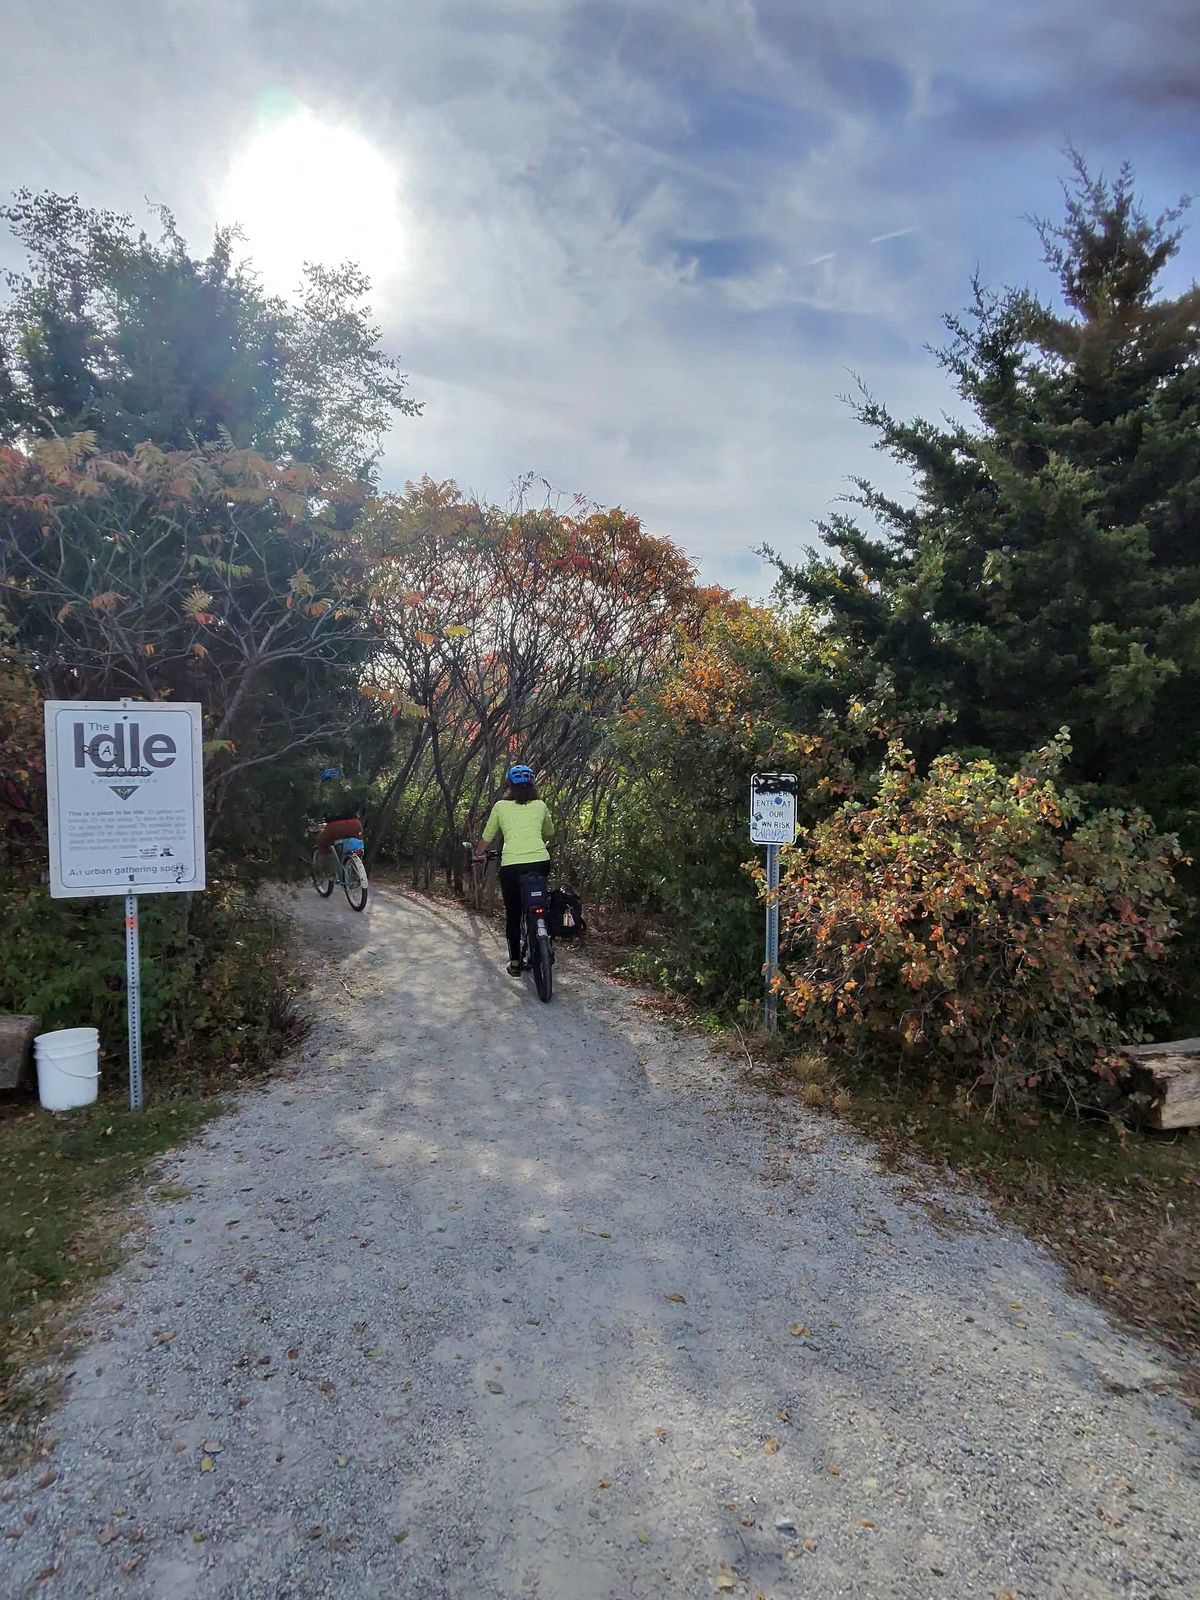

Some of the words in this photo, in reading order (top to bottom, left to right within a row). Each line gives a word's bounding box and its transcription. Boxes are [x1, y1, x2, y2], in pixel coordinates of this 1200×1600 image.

[89, 723, 109, 731] The
[73, 723, 177, 768] Idle
[114, 866, 157, 876] gathering
